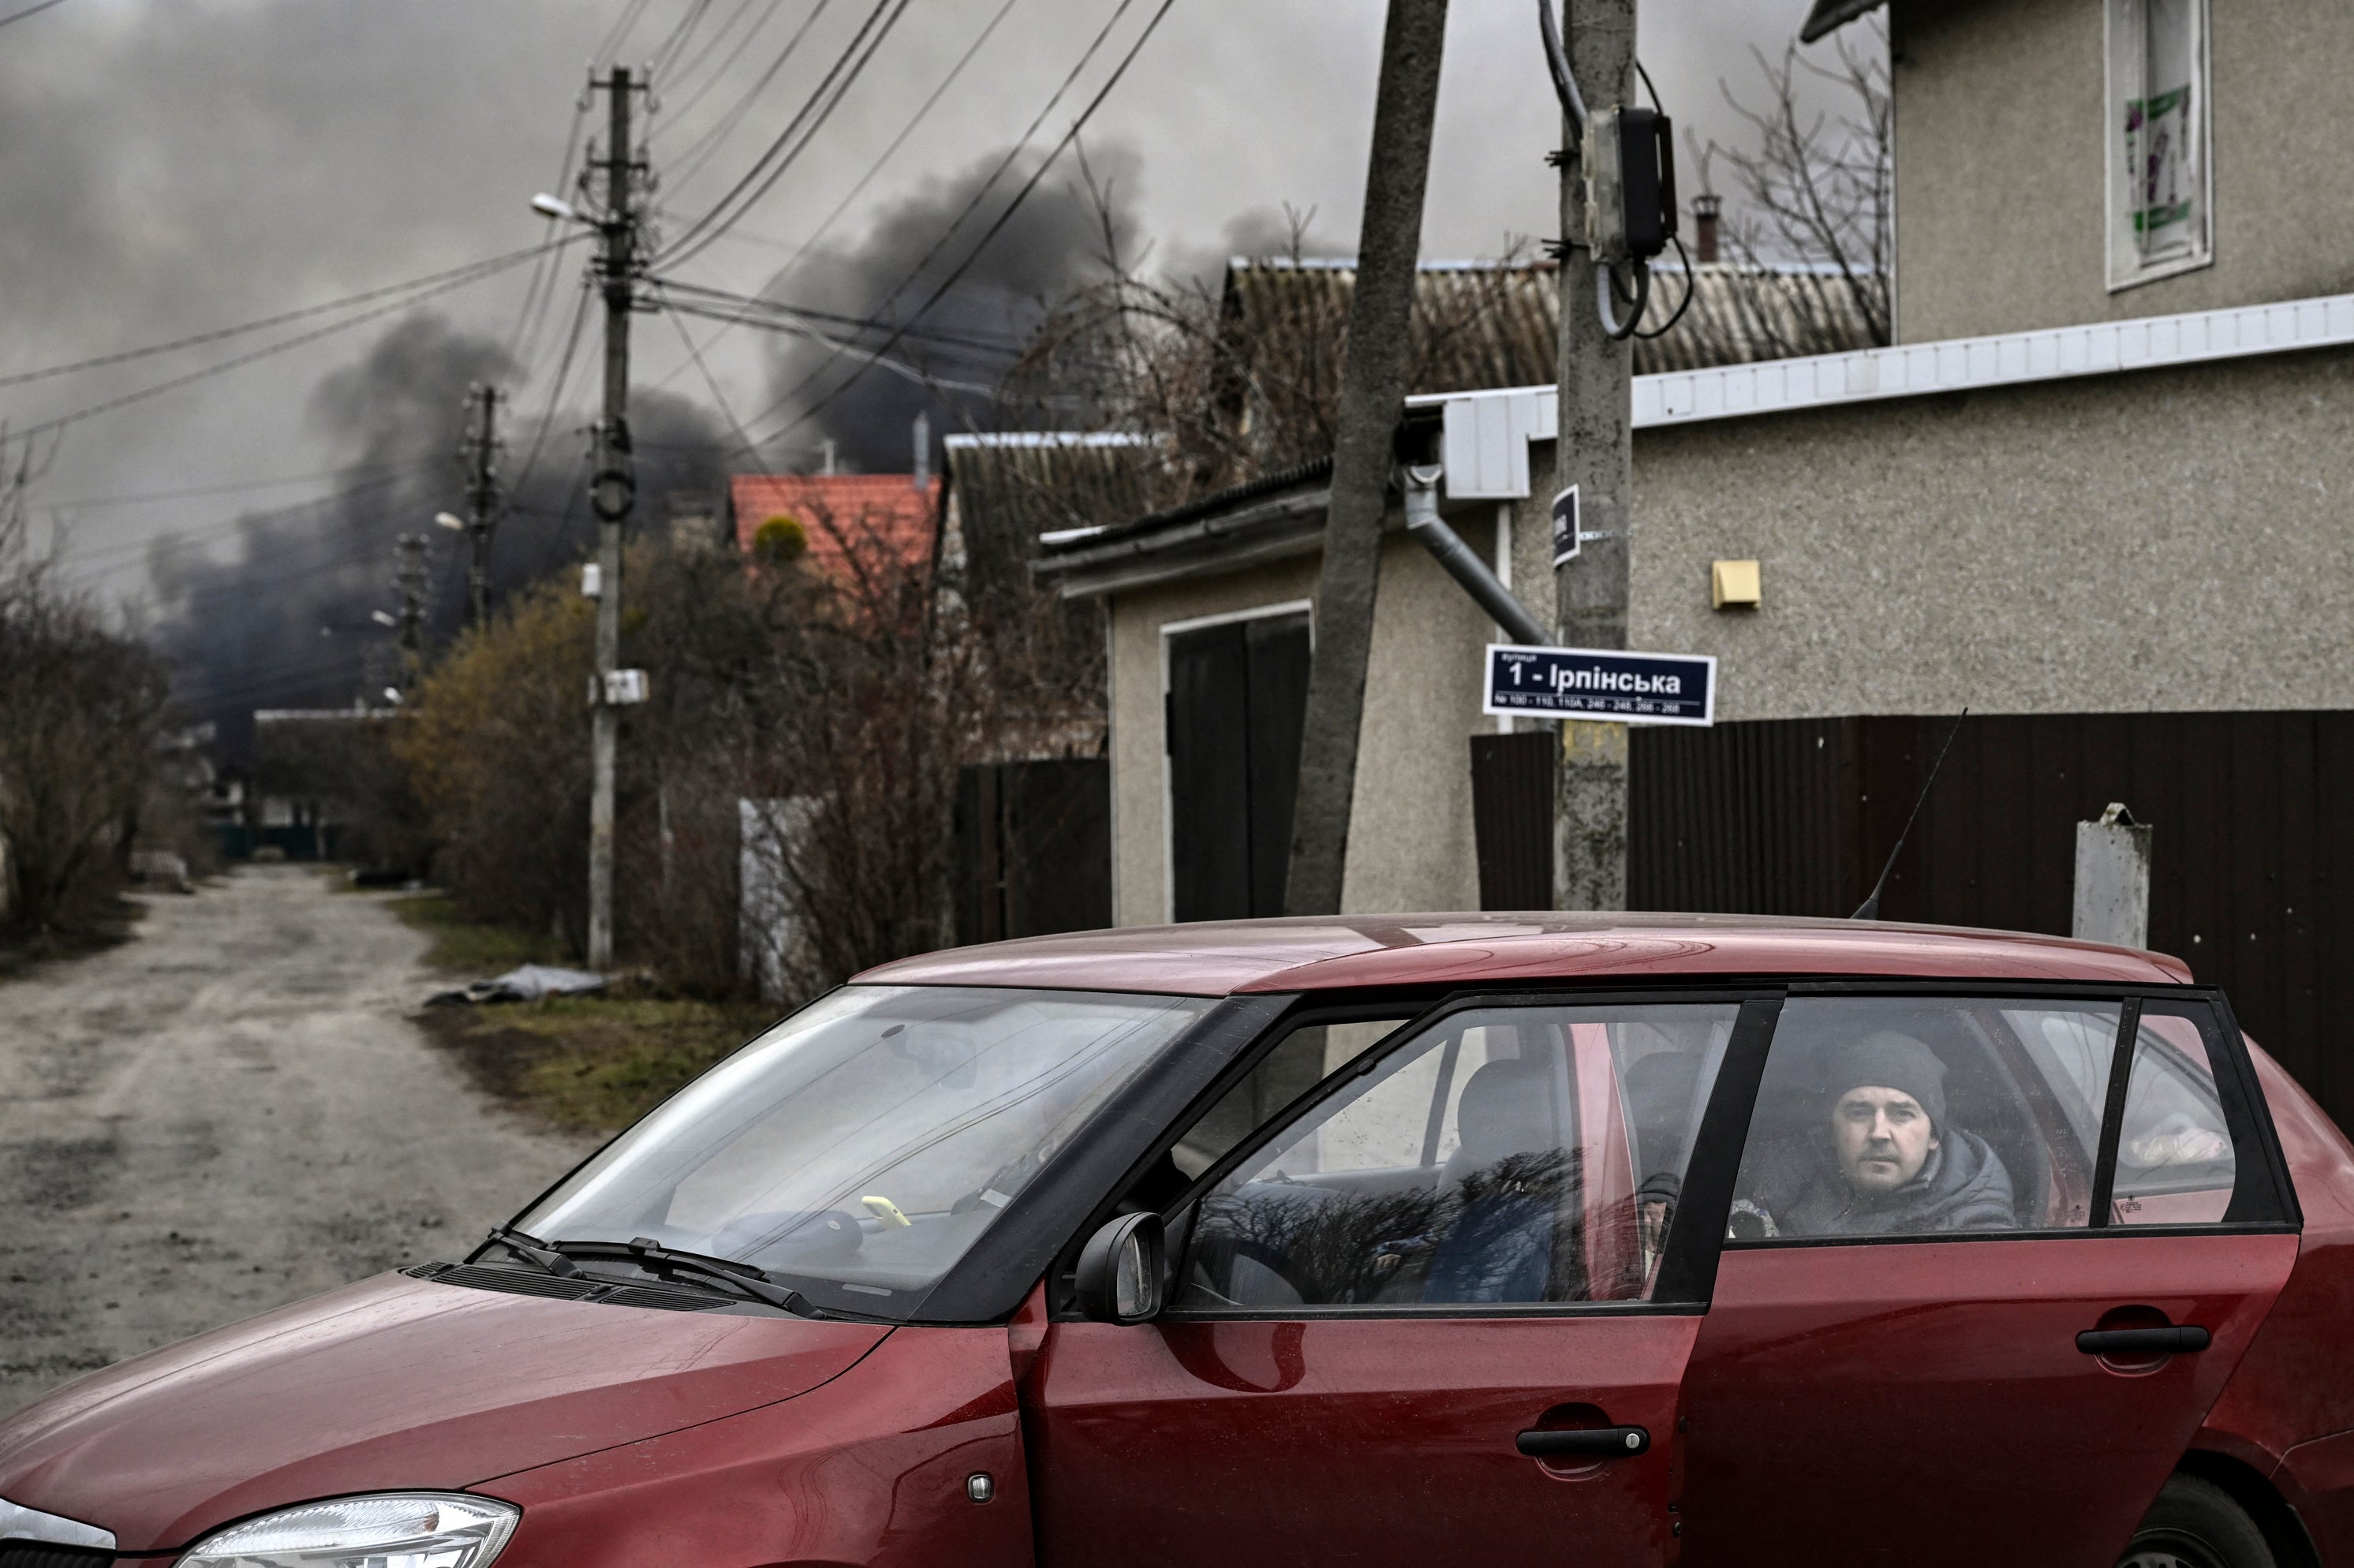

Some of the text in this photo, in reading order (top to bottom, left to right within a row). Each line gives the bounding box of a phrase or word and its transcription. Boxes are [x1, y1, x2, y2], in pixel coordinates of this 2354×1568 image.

[1508, 662, 1682, 695] 1 - Ірпінська
